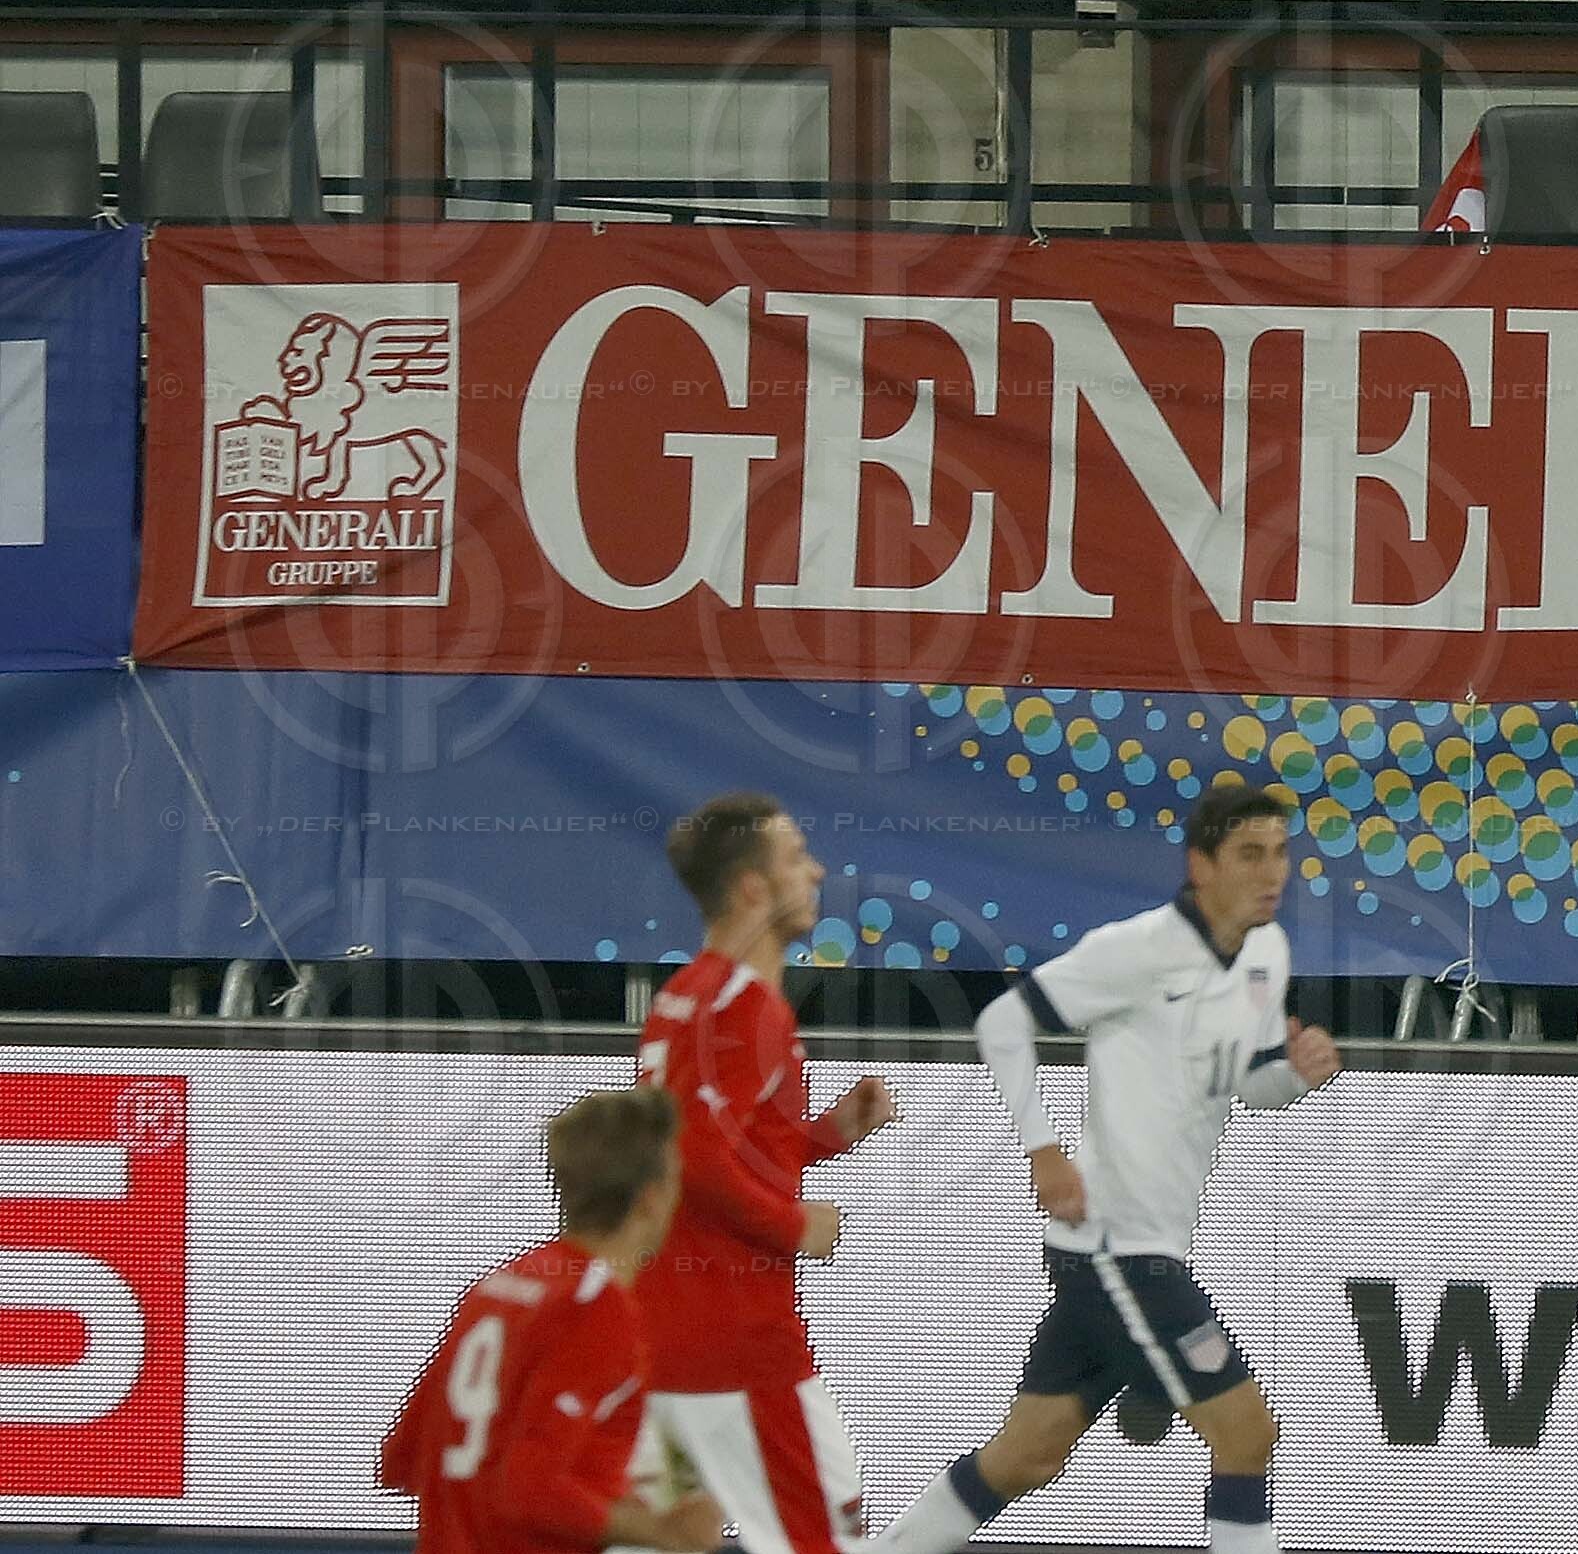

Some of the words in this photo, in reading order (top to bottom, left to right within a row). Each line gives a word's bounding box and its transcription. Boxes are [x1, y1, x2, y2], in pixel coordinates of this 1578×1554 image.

[975, 138, 993, 172] 5
[212, 509, 439, 552] GENERALI
[266, 560, 379, 586] GRUPPE
[441, 1314, 504, 1481] 9
